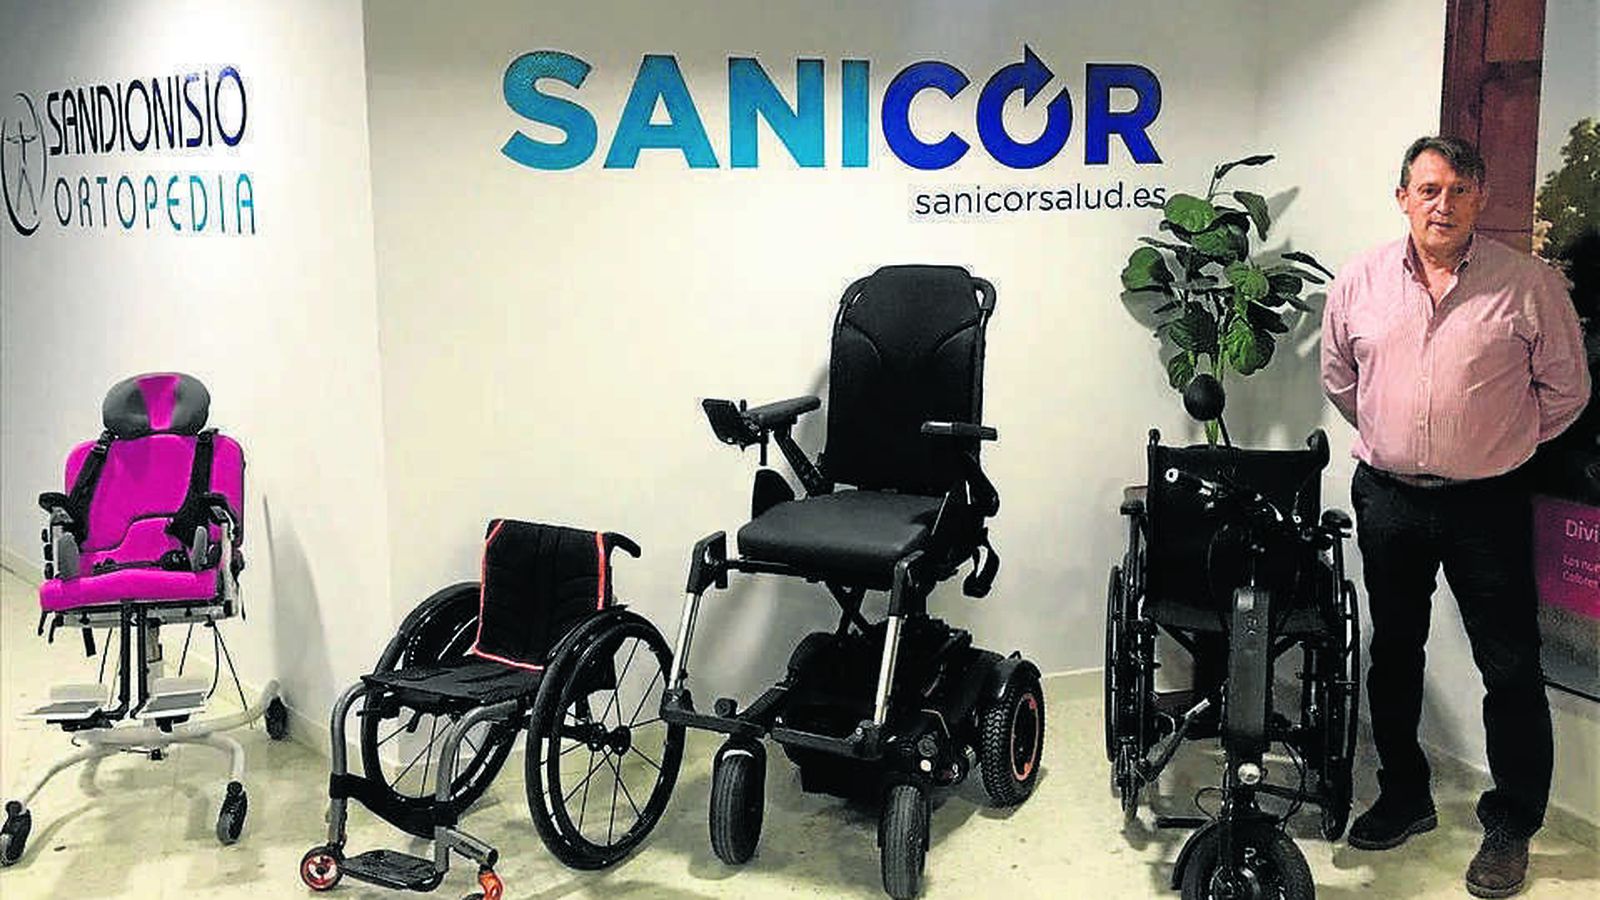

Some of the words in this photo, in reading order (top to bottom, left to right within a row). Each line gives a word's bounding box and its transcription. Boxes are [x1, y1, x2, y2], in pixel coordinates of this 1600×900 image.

[47, 66, 247, 156] SANDIONISIO
[500, 44, 1164, 170] SANICOR
[54, 173, 255, 235] ORTOPEDIA
[915, 181, 1167, 215] sanicorsalud.es
